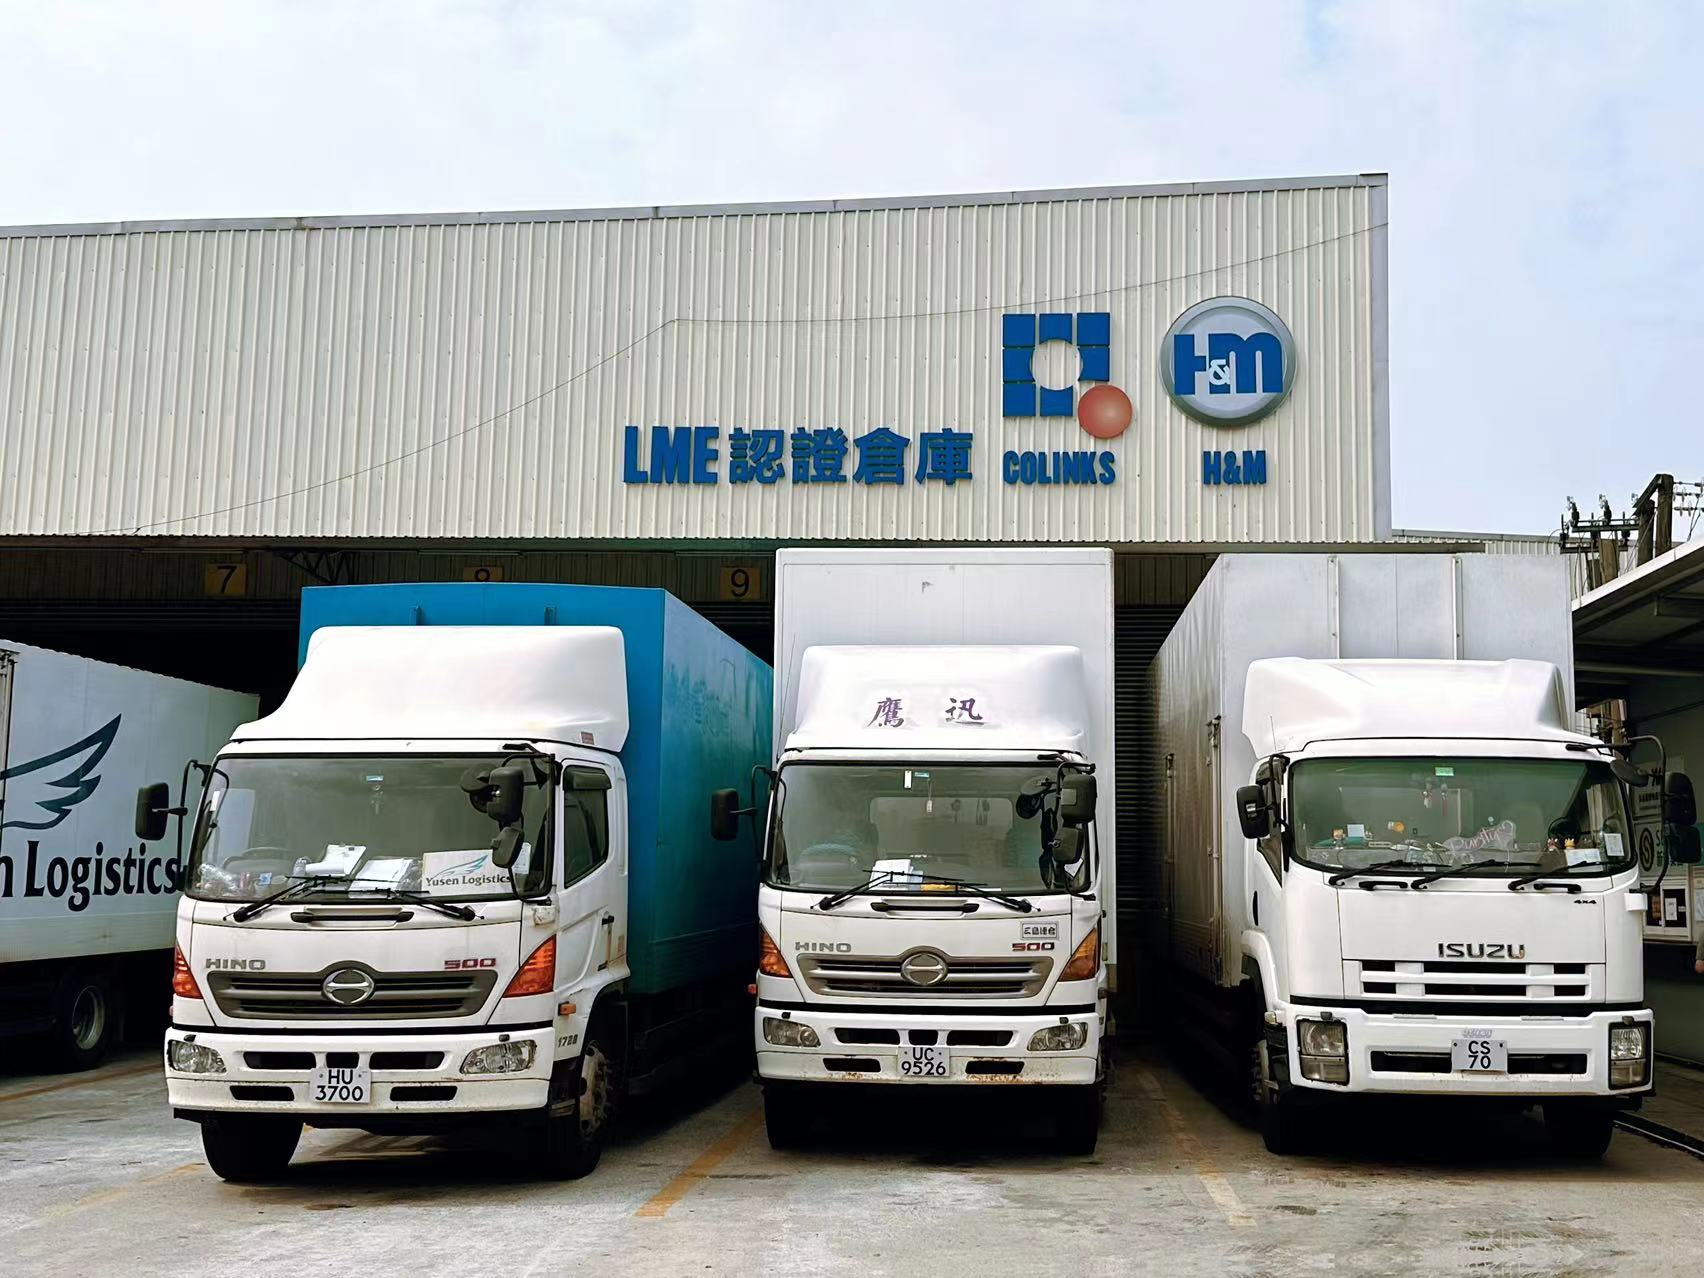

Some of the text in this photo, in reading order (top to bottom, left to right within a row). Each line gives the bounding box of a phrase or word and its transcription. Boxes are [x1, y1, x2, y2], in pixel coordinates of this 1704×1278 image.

[623, 426, 973, 485] LME 認證倉庫
[1002, 450, 1116, 485] COLINKS
[1203, 450, 1267, 485] H&M
[216, 565, 238, 594] 7
[731, 569, 750, 597] 9
[24, 840, 179, 912] Logistics
[426, 873, 511, 886] Yusen Logistics
[795, 942, 851, 952] HINO
[1012, 942, 1055, 951] 500
[1438, 943, 1525, 959] ISUZU
[205, 958, 266, 970] HINO
[444, 958, 496, 968] 500
[912, 1047, 934, 1061] UC
[1468, 1040, 1491, 1055] CS
[901, 1060, 946, 1075] 9526
[1468, 1055, 1491, 1069] 70
[328, 1069, 353, 1084] HU
[315, 1085, 363, 1101] 3700
